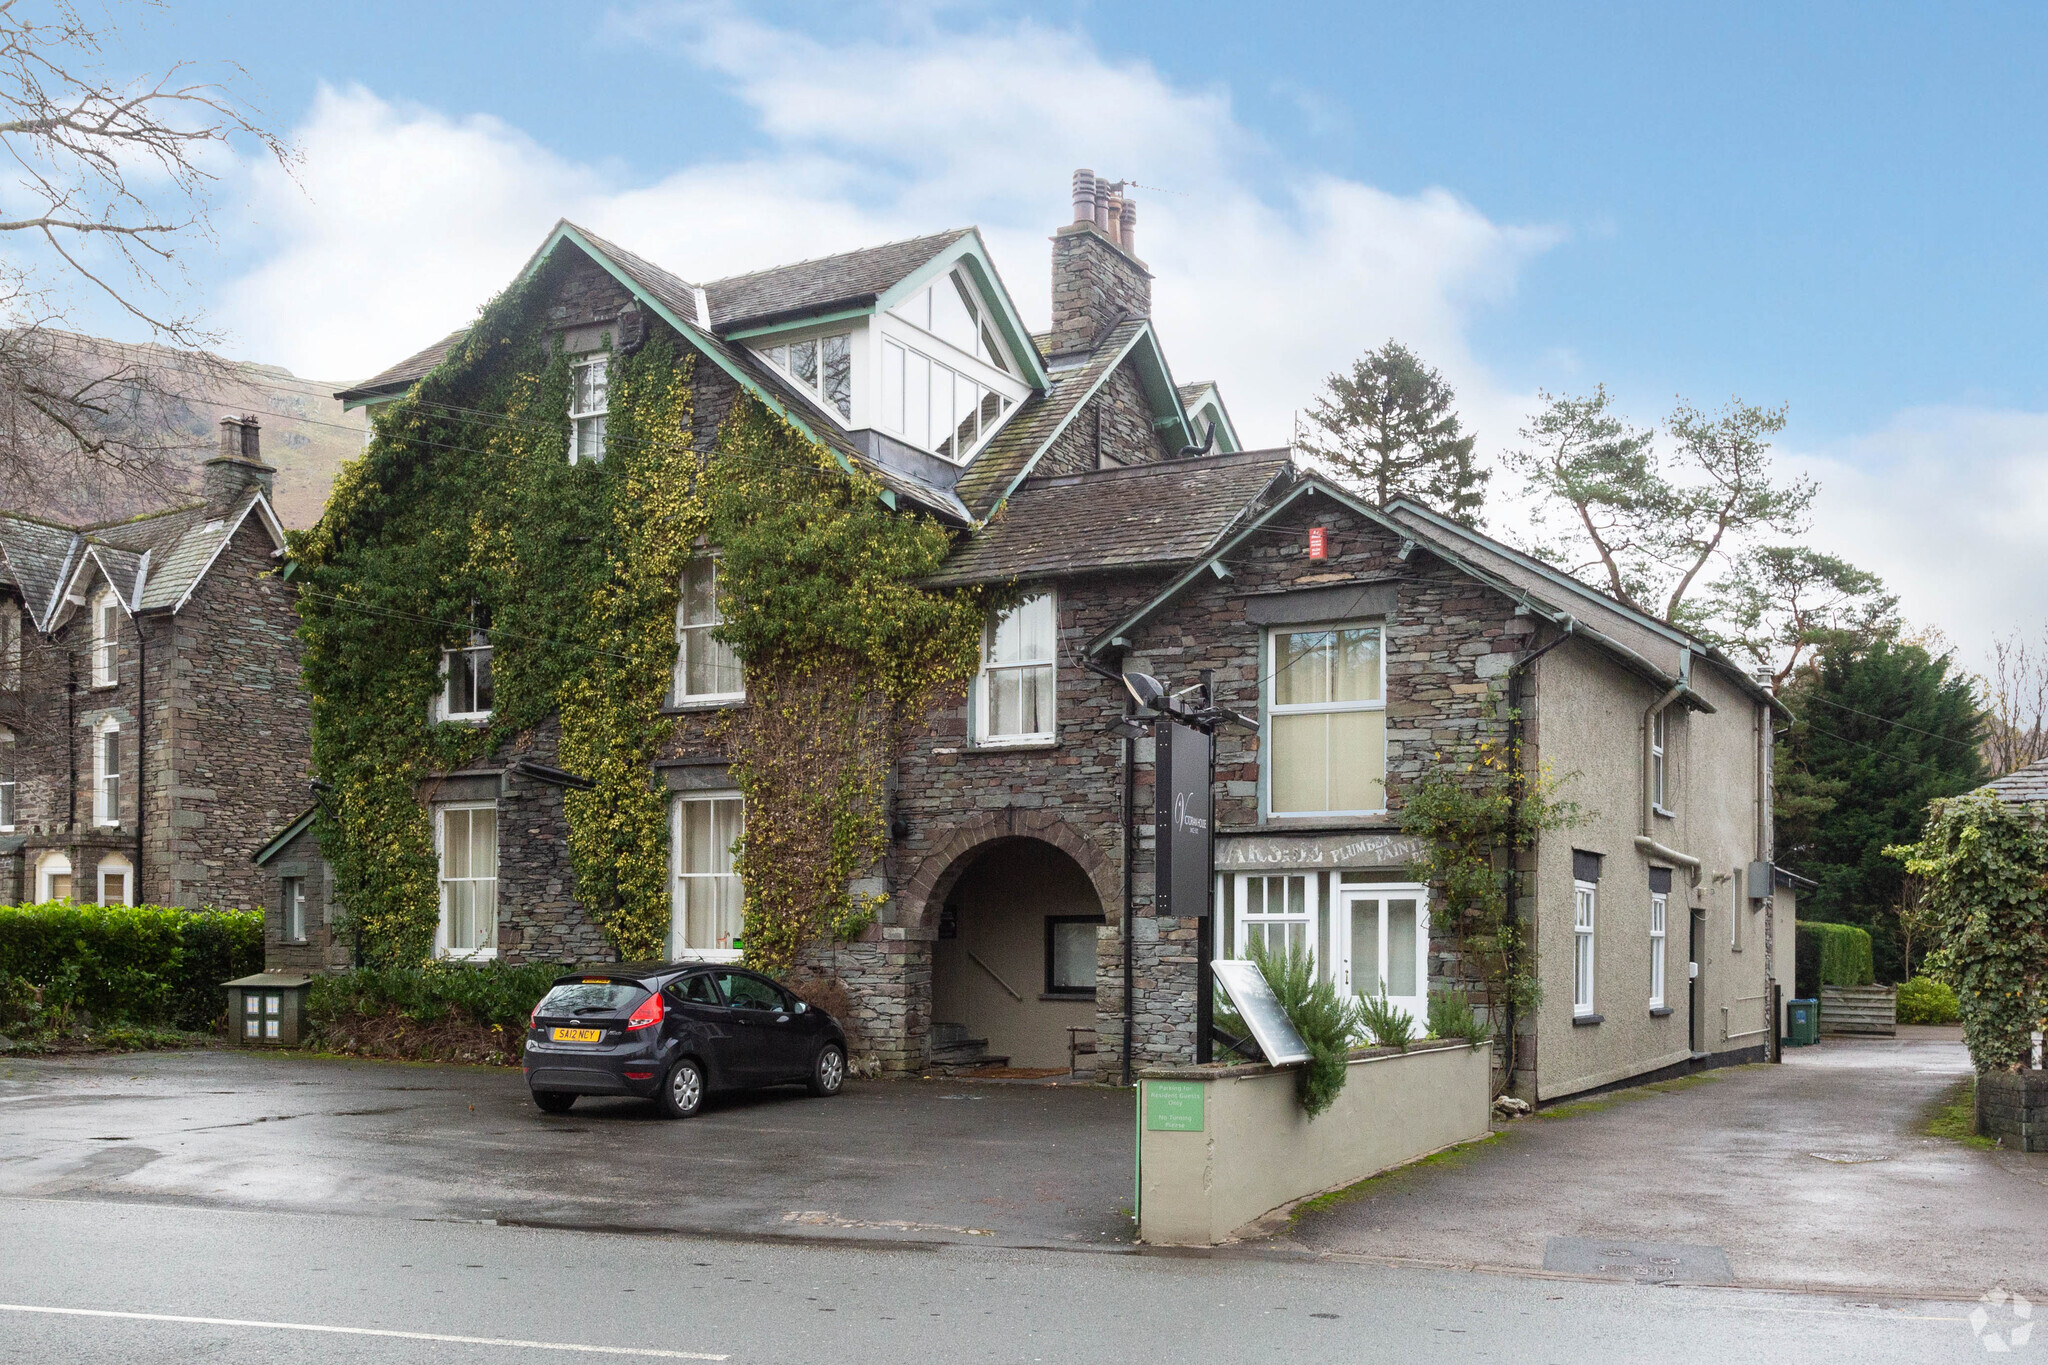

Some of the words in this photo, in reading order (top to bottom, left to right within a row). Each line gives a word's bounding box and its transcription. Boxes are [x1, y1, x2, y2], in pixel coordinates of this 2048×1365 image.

[1330, 835, 1393, 863] PLUMBER
[559, 1029, 577, 1039] SA12
[1169, 1114, 1192, 1122] Turning
